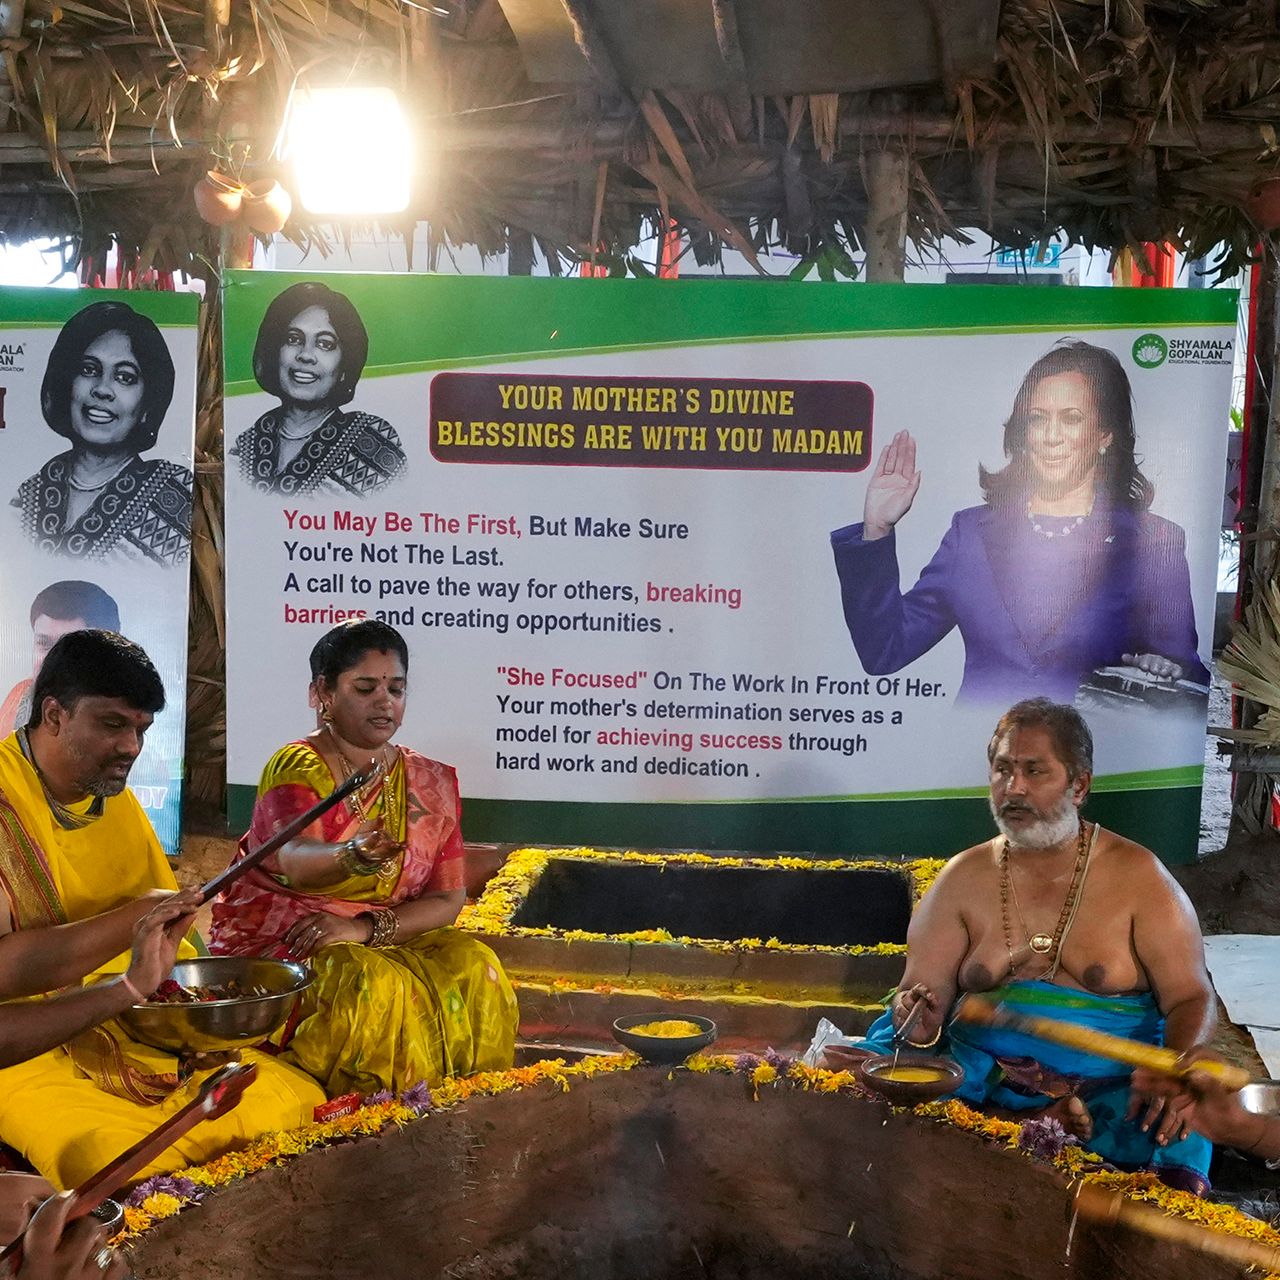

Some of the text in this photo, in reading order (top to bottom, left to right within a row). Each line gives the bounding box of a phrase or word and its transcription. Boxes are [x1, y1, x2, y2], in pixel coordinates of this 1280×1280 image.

[1168, 350, 1223, 359] GOPALAN
[1169, 339, 1232, 350] SHYAMALA
[499, 385, 794, 415] YOUR MOTHER'S DIVINE
[438, 421, 862, 454] BLESSINGS ARE WITH YOU MADAM
[284, 510, 688, 539] You May Be The First, But Make Sure
[284, 541, 503, 566] You're Not The Last.
[284, 573, 741, 609] A call to pave the way for others, breaking
[285, 604, 661, 635] barriers and creating opportunities
[498, 667, 945, 697] "She Focused" On The Work In Front Of Her.
[497, 695, 902, 724] Your mother's determination serves as a
[497, 725, 866, 756] model for achieving success through
[497, 752, 748, 777] hard work and dedication
